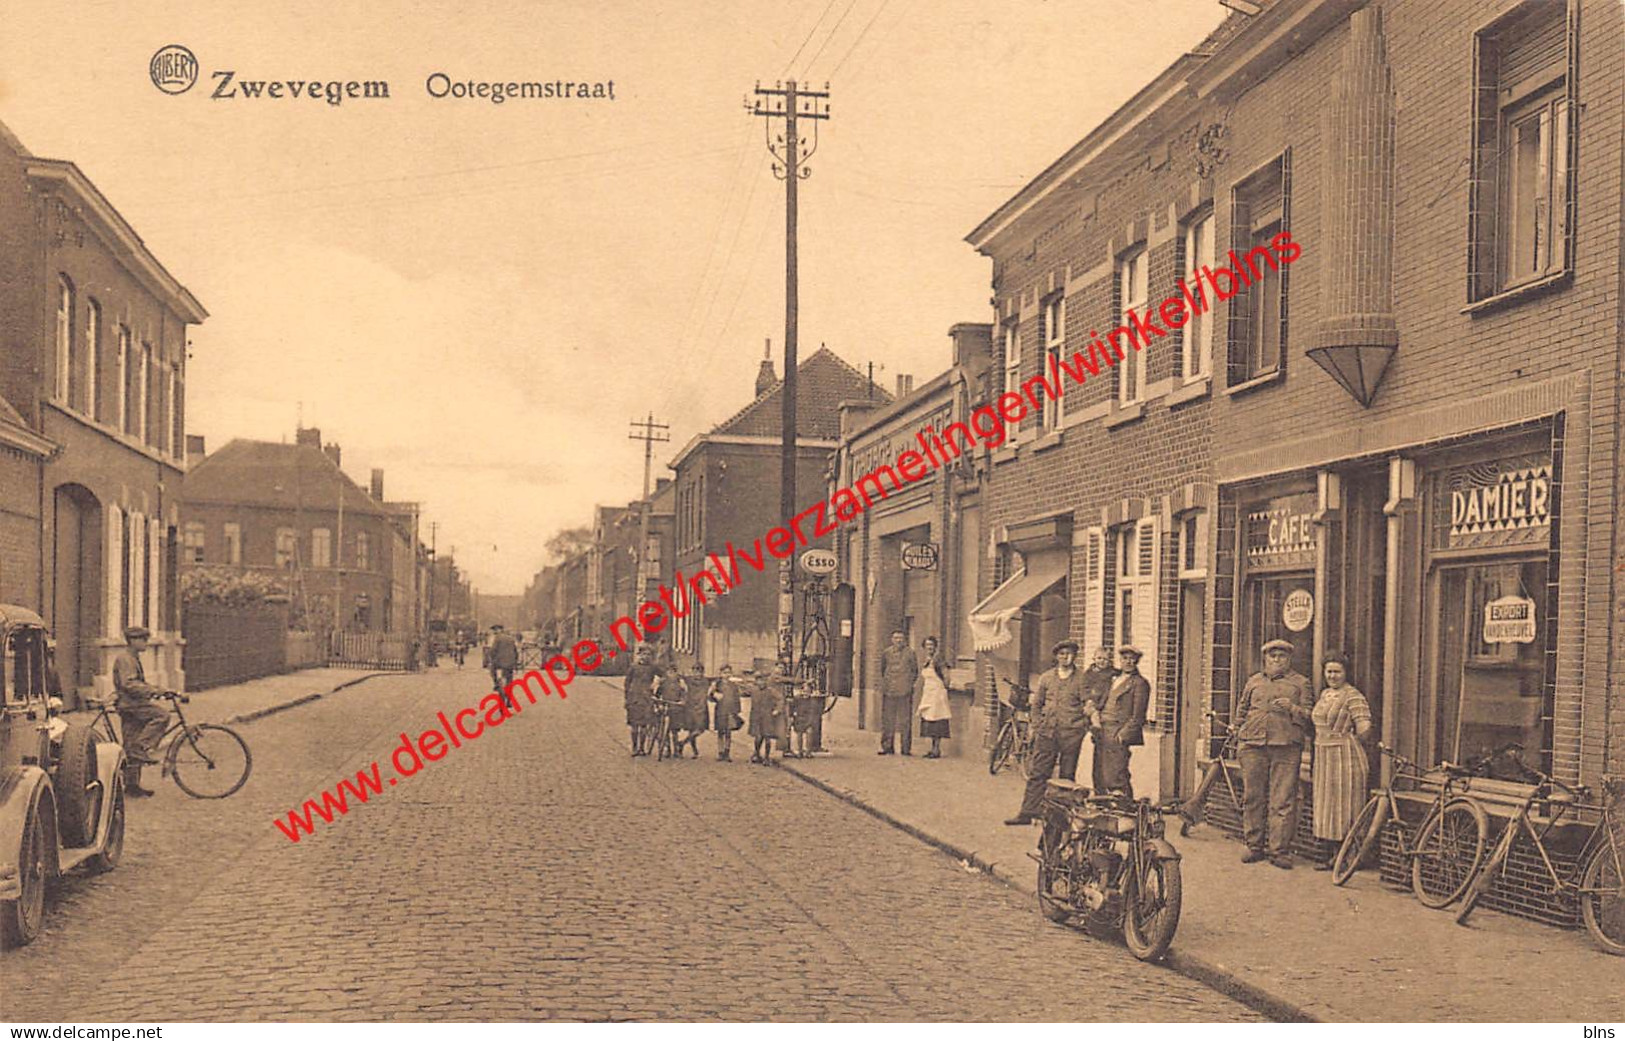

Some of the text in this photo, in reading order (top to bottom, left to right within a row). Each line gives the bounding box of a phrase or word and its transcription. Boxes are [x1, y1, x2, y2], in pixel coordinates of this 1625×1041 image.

[1452, 478, 1548, 526] DAMIER
[1268, 515, 1311, 546] CAFE
[1491, 604, 1528, 620] EXPORT
